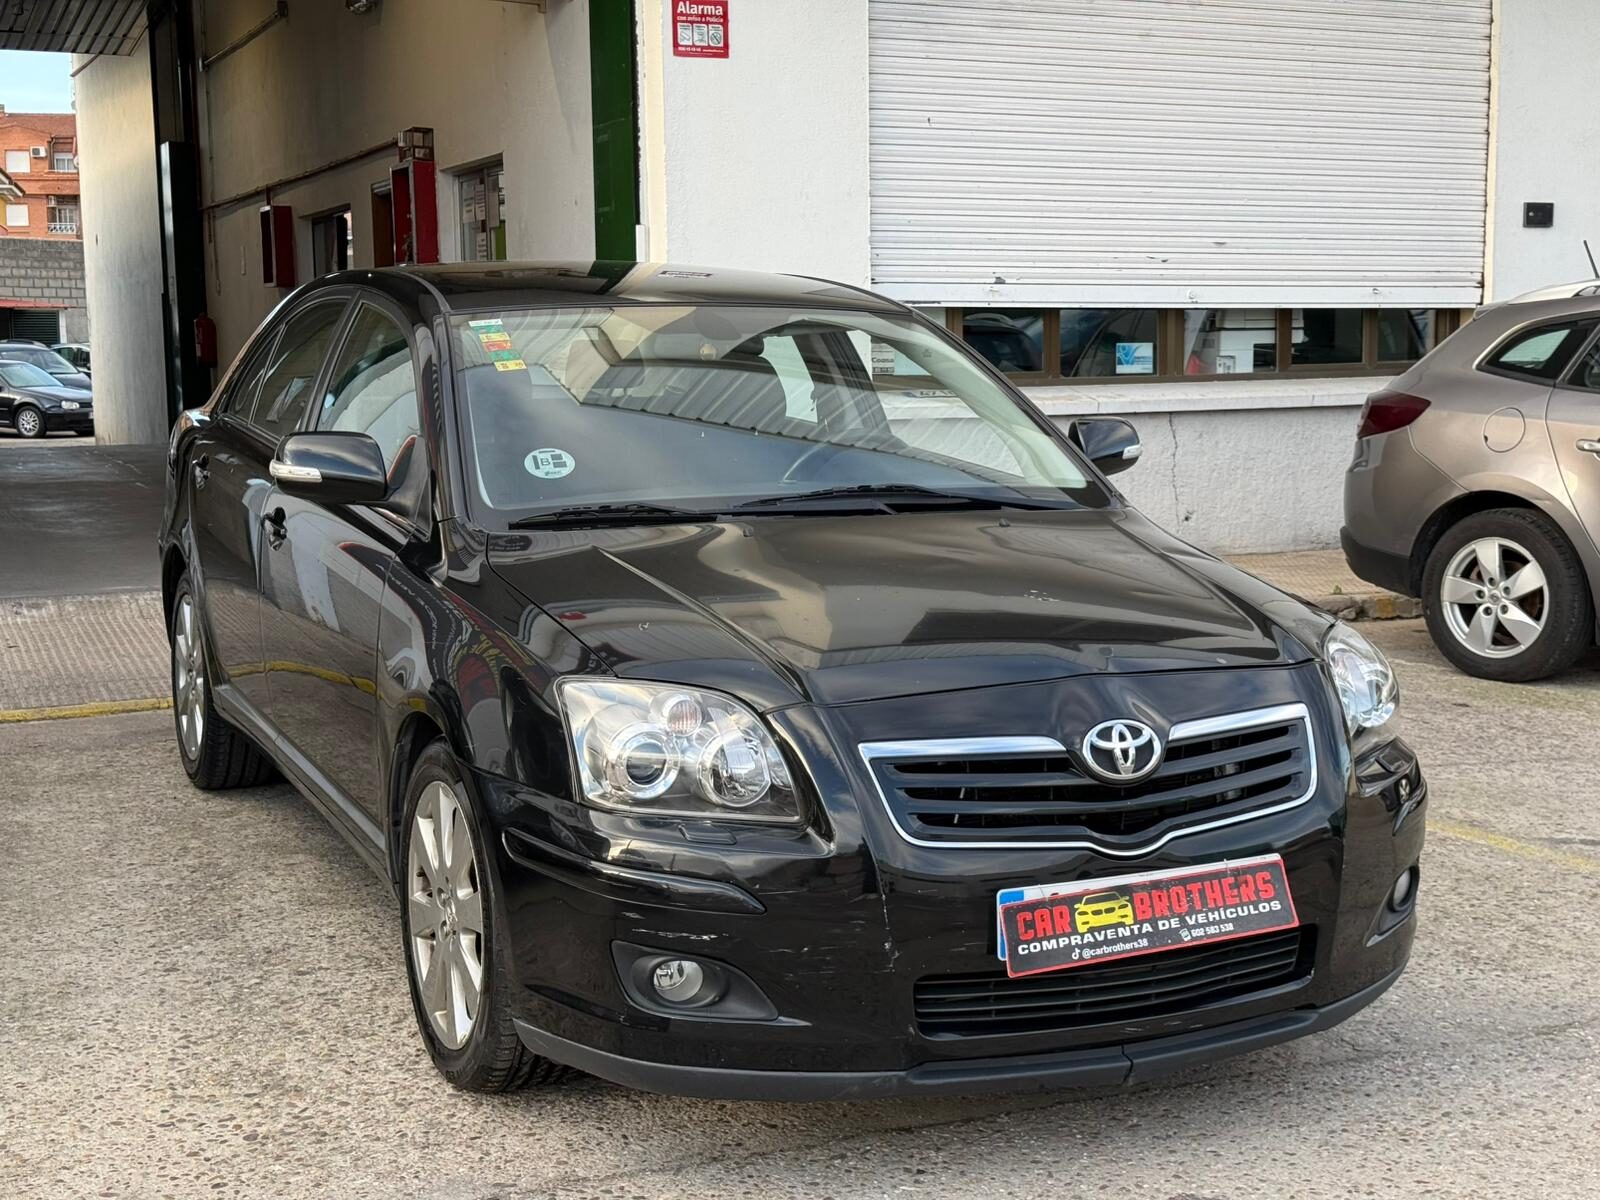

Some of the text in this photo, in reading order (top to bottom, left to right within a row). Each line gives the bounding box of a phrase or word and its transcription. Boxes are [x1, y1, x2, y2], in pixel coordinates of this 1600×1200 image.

[677, 1, 723, 16] Alarma
[540, 458, 550, 466] B
[1016, 871, 1276, 941] CAR BROTHERS
[1017, 900, 1282, 955] COMPRAVENTA DE VEHÍCULOS
[1082, 938, 1149, 959] @carbrothers38
